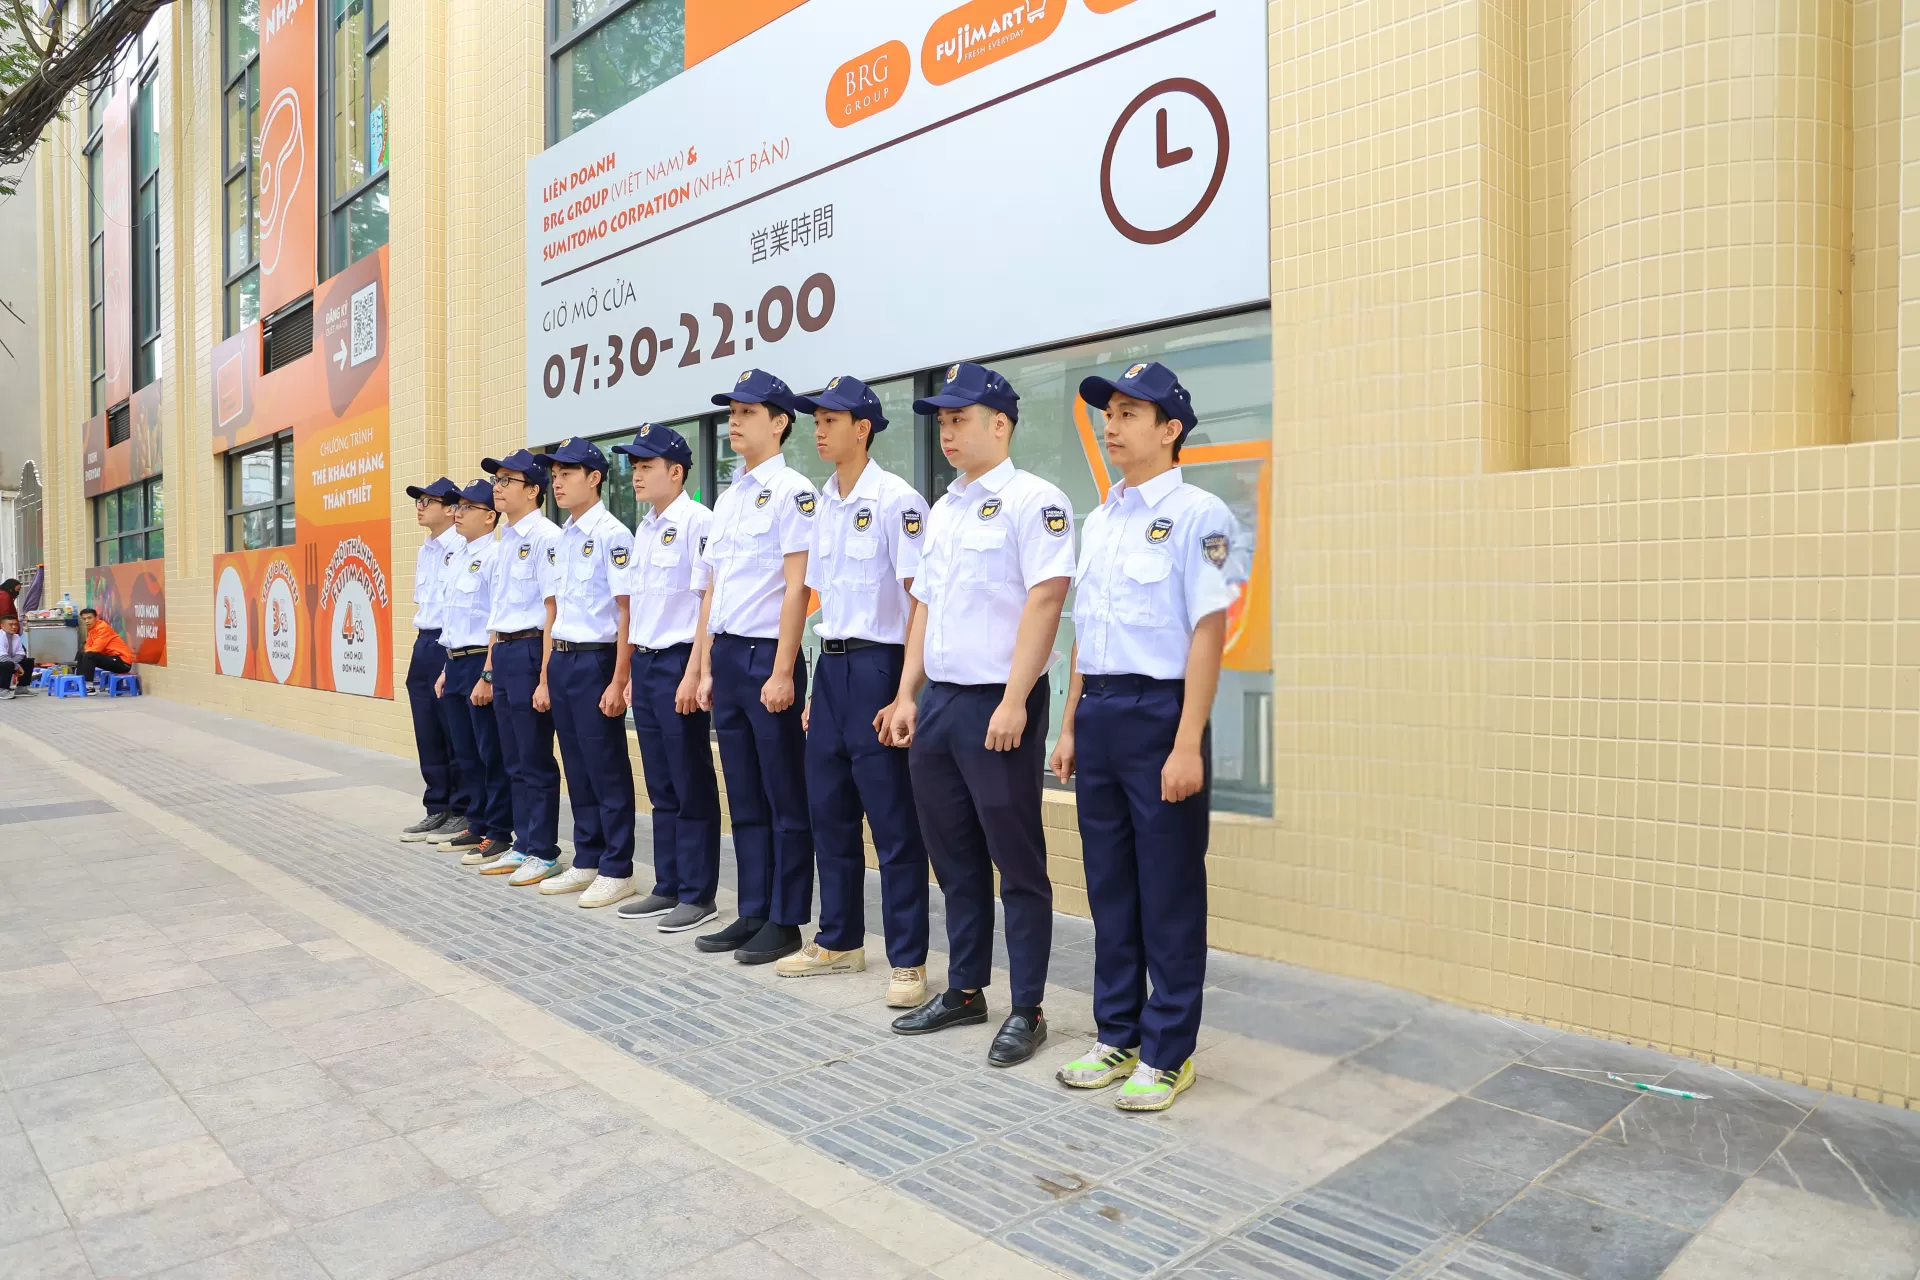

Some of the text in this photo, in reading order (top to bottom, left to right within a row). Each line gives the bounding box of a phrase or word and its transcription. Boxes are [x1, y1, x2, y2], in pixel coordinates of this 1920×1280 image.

[964, 28, 1025, 60] FRESH EVERYDAY
[845, 88, 889, 115] GROUP
[846, 54, 888, 97] BRG
[543, 152, 616, 204] LIÊN DOANH
[543, 208, 564, 232] BRG
[567, 187, 609, 220] GROUP
[646, 150, 685, 184] NAM)
[687, 146, 698, 166] &
[543, 137, 790, 262] SUMITOMO CORPATION (NHẬT BẢN)
[751, 204, 834, 264] 営業時間
[542, 278, 636, 332] GIỜ MỞ CỬA
[543, 273, 836, 399] 07:30-22:00
[328, 458, 356, 482] KHÁCH
[358, 452, 384, 475] HÀNG
[331, 564, 376, 604] FUJIMART
